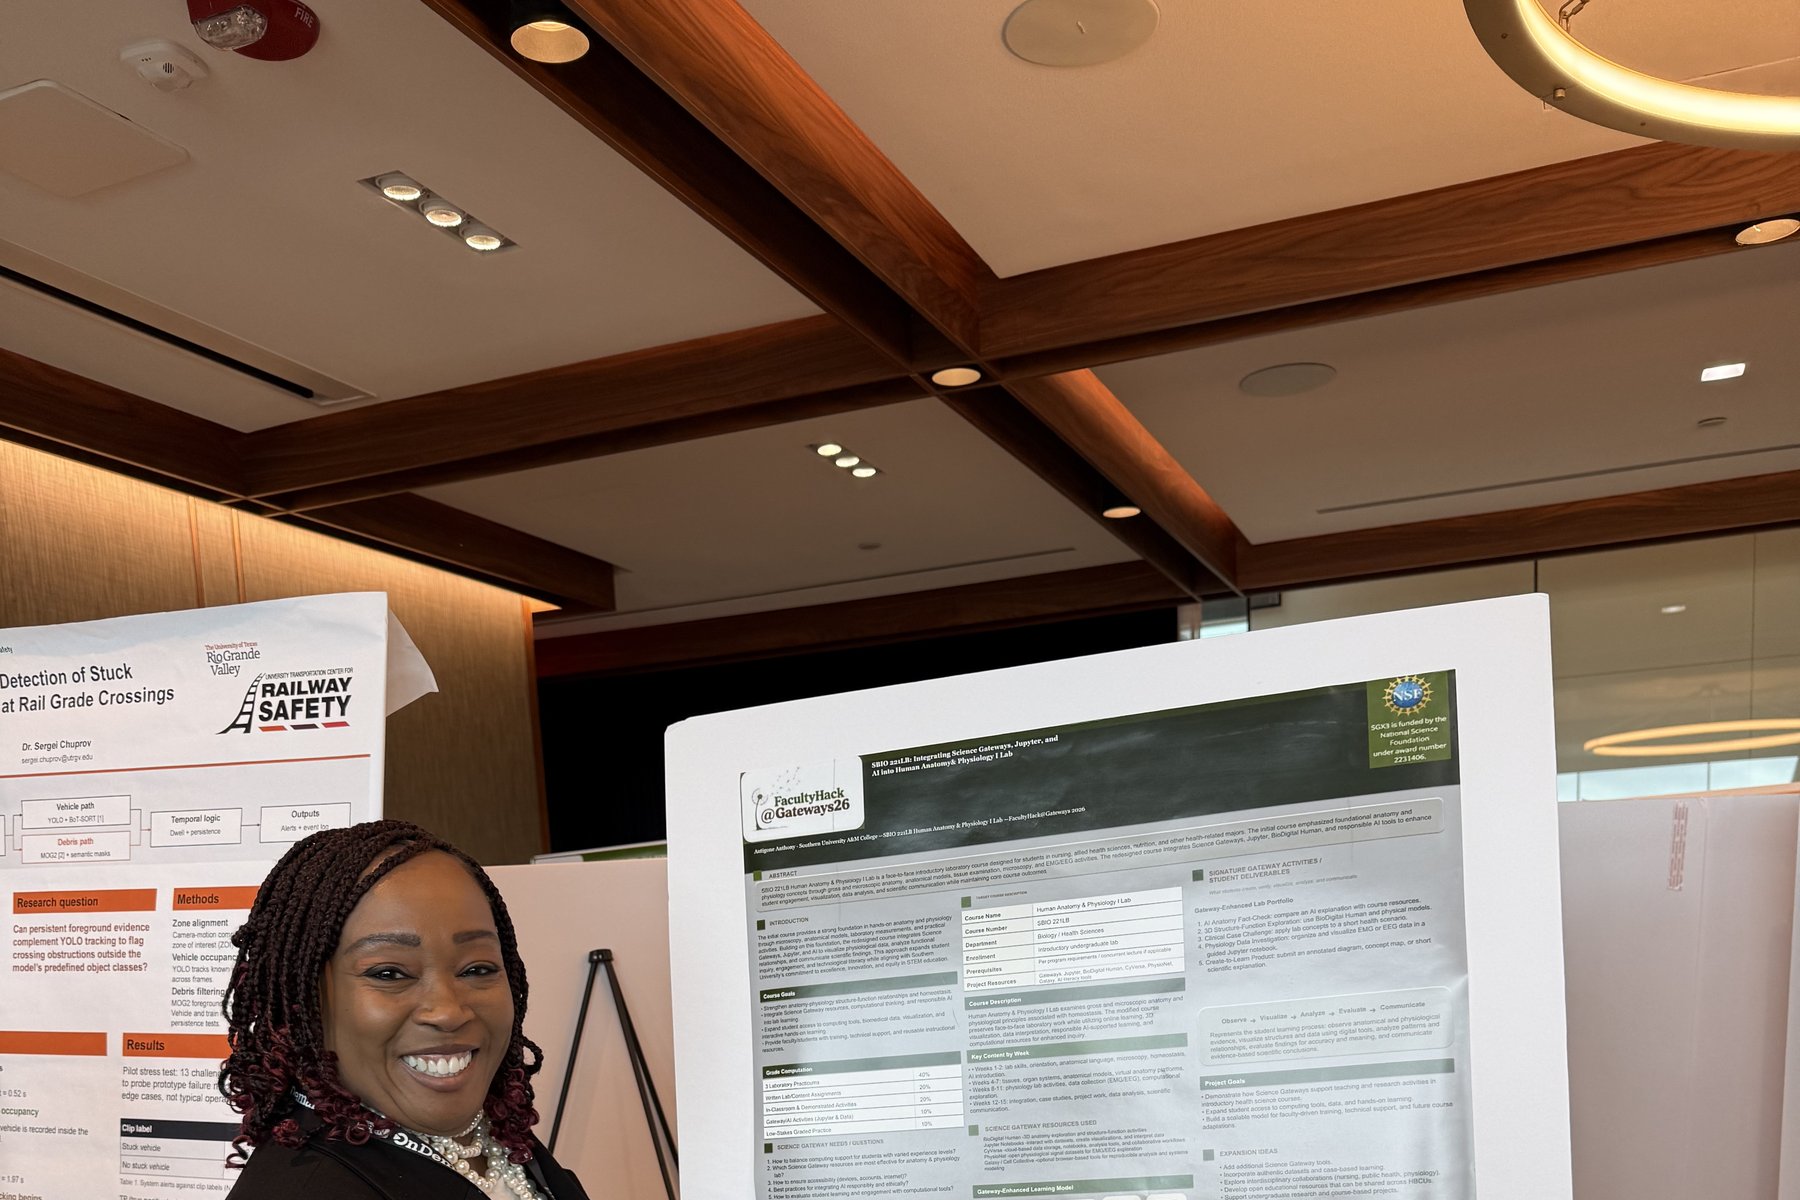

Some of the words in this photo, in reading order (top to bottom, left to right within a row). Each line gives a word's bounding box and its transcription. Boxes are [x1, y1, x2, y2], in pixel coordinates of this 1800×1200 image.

[294, 6, 314, 28] FIRE
[207, 651, 222, 663] Rio
[223, 648, 260, 662] Grande
[72, 666, 84, 682] of
[90, 664, 132, 680] Stuck
[210, 663, 240, 677] Valley
[265, 672, 289, 680] UNIVERSITY
[262, 676, 352, 698] RAILWAY
[2, 698, 14, 712] at
[19, 695, 44, 710] Rail
[50, 692, 92, 708] Grade
[98, 688, 173, 704] Crossings
[1393, 688, 1423, 702] NSF
[258, 694, 352, 722] SAFETY
[1398, 718, 1423, 726] funded
[34, 741, 57, 750] Sergei
[60, 740, 91, 748] Chuprov
[1390, 736, 1429, 744] Foundation
[913, 752, 950, 761] Integrating
[921, 759, 955, 768] Anatomy&
[958, 755, 993, 763] Physiology
[774, 787, 845, 807] FacultyHack
[80, 802, 94, 810] path
[761, 798, 850, 823] @Gateways26
[171, 815, 202, 823] Temporal
[203, 814, 220, 822] logic
[291, 810, 319, 818] Outputs
[769, 870, 796, 878] ABSTRACT
[17, 898, 56, 907] Research
[59, 897, 97, 908] question
[177, 894, 218, 903] Methods
[13, 924, 27, 933] Can
[29, 924, 66, 934] persistent
[68, 923, 111, 933] foreground
[114, 923, 149, 931] evidence
[192, 919, 227, 928] alignment
[12, 938, 58, 946] complement
[60, 936, 82, 945] YOLO
[84, 936, 116, 946] tracking
[128, 936, 143, 946] flag
[12, 951, 44, 960] crossing
[47, 950, 94, 958] obstructions
[97, 949, 126, 958] outside
[128, 949, 140, 957] the
[12, 963, 41, 971] model's
[44, 963, 84, 972] predefined
[86, 963, 110, 972] object
[112, 962, 147, 971] classes?
[197, 987, 226, 998] filtering
[127, 1039, 164, 1050] Results
[123, 1066, 137, 1074] Pilot
[1, 1108, 38, 1117] occupancy
[122, 1124, 134, 1132] Clip
